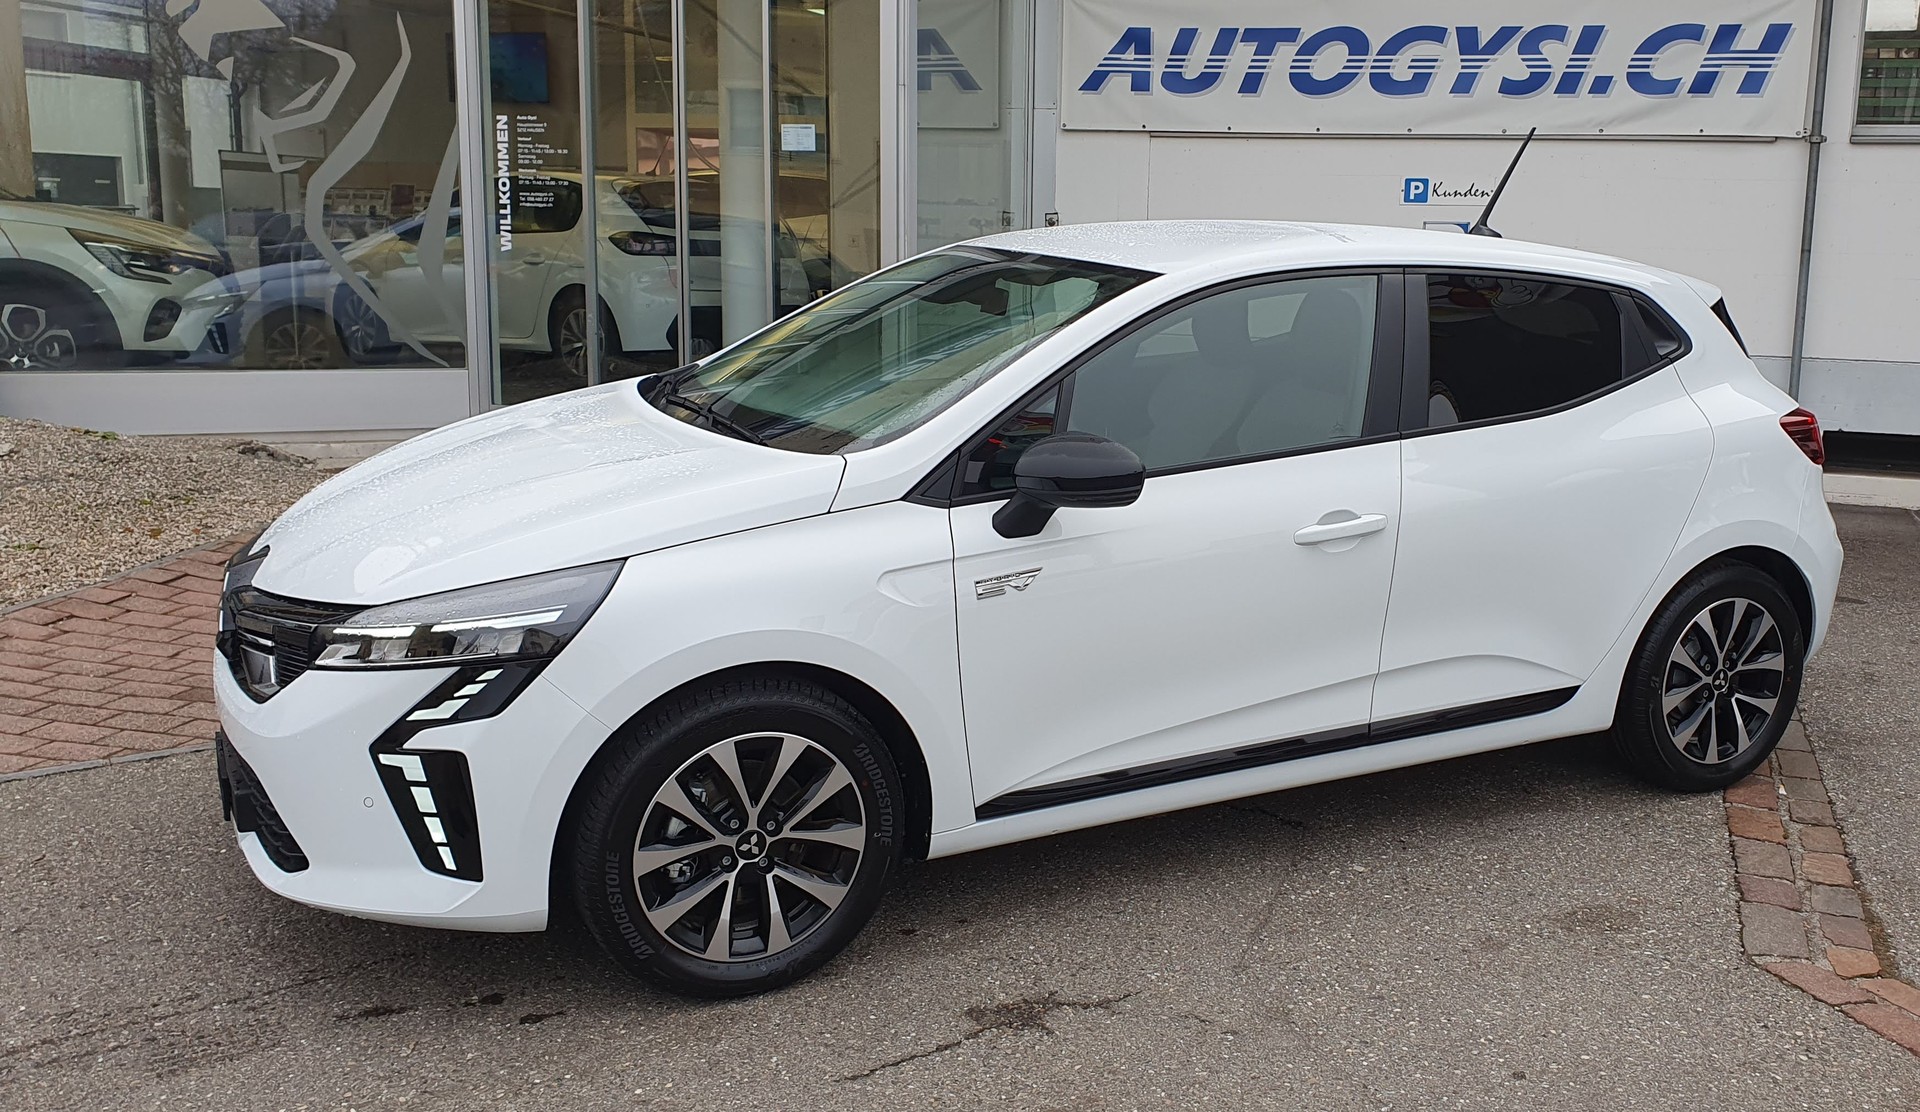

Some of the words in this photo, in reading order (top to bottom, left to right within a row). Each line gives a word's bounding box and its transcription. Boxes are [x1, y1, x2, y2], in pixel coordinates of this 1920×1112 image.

[1078, 23, 1794, 98] AUTOGYSI.CH
[496, 114, 513, 252] WILLKOMMEN
[1431, 181, 1491, 198] Kunden
[852, 743, 894, 847] BRIDGESTONE
[605, 850, 656, 960] BRIDGESTONE
